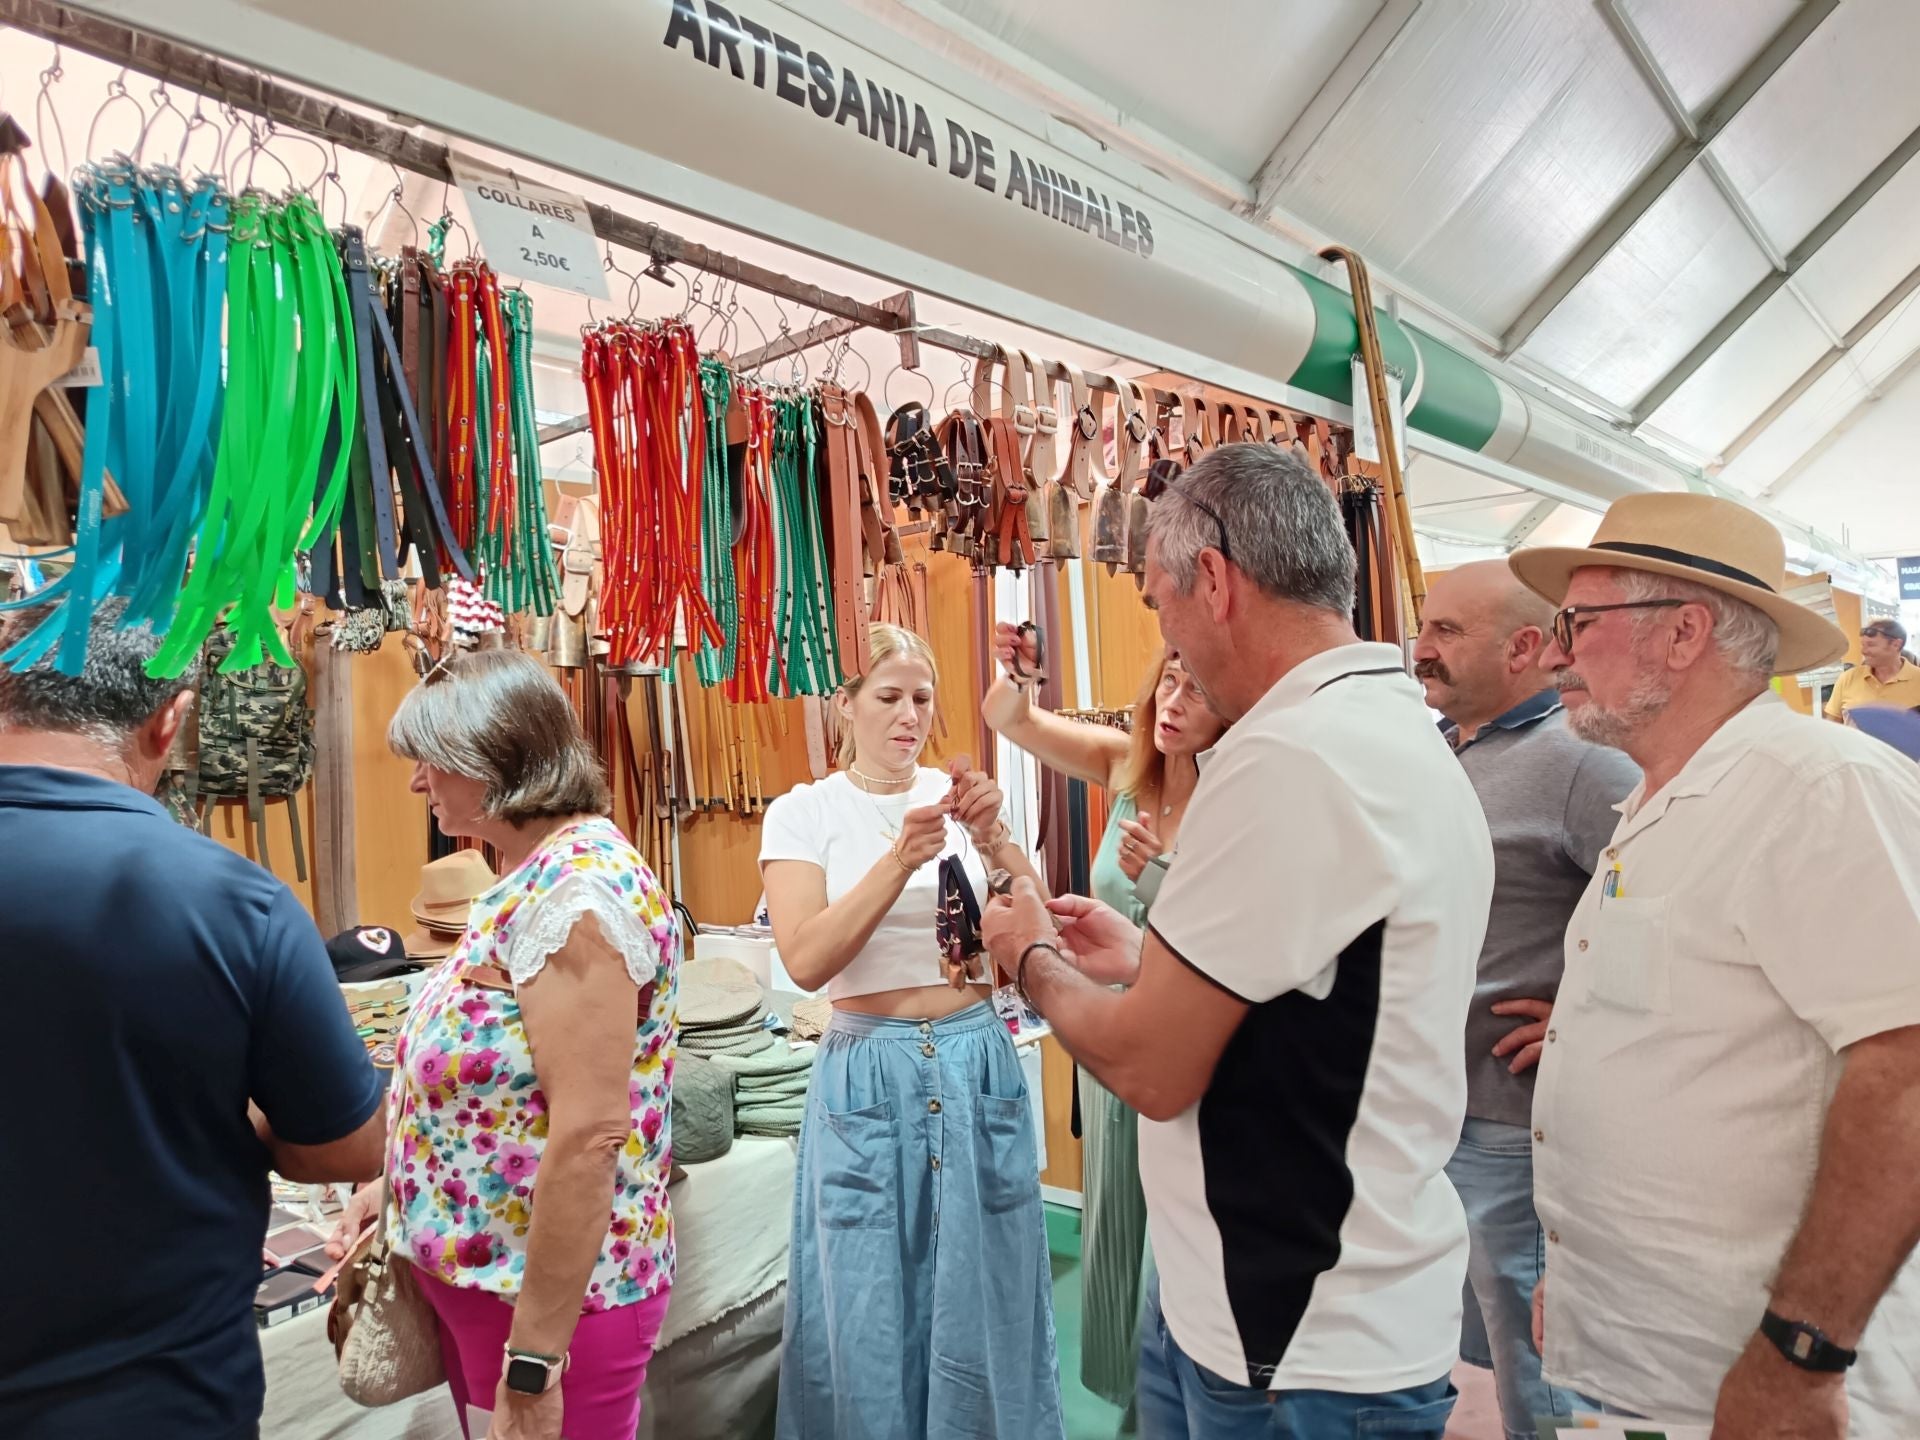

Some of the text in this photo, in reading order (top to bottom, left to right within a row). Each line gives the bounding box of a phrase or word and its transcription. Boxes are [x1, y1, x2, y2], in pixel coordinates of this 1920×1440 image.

[663, 0, 1155, 259] ARTESANIA DE ANIMALES
[477, 186, 576, 223] COLLARES
[531, 224, 545, 240] A
[520, 247, 570, 271] 2,50€
